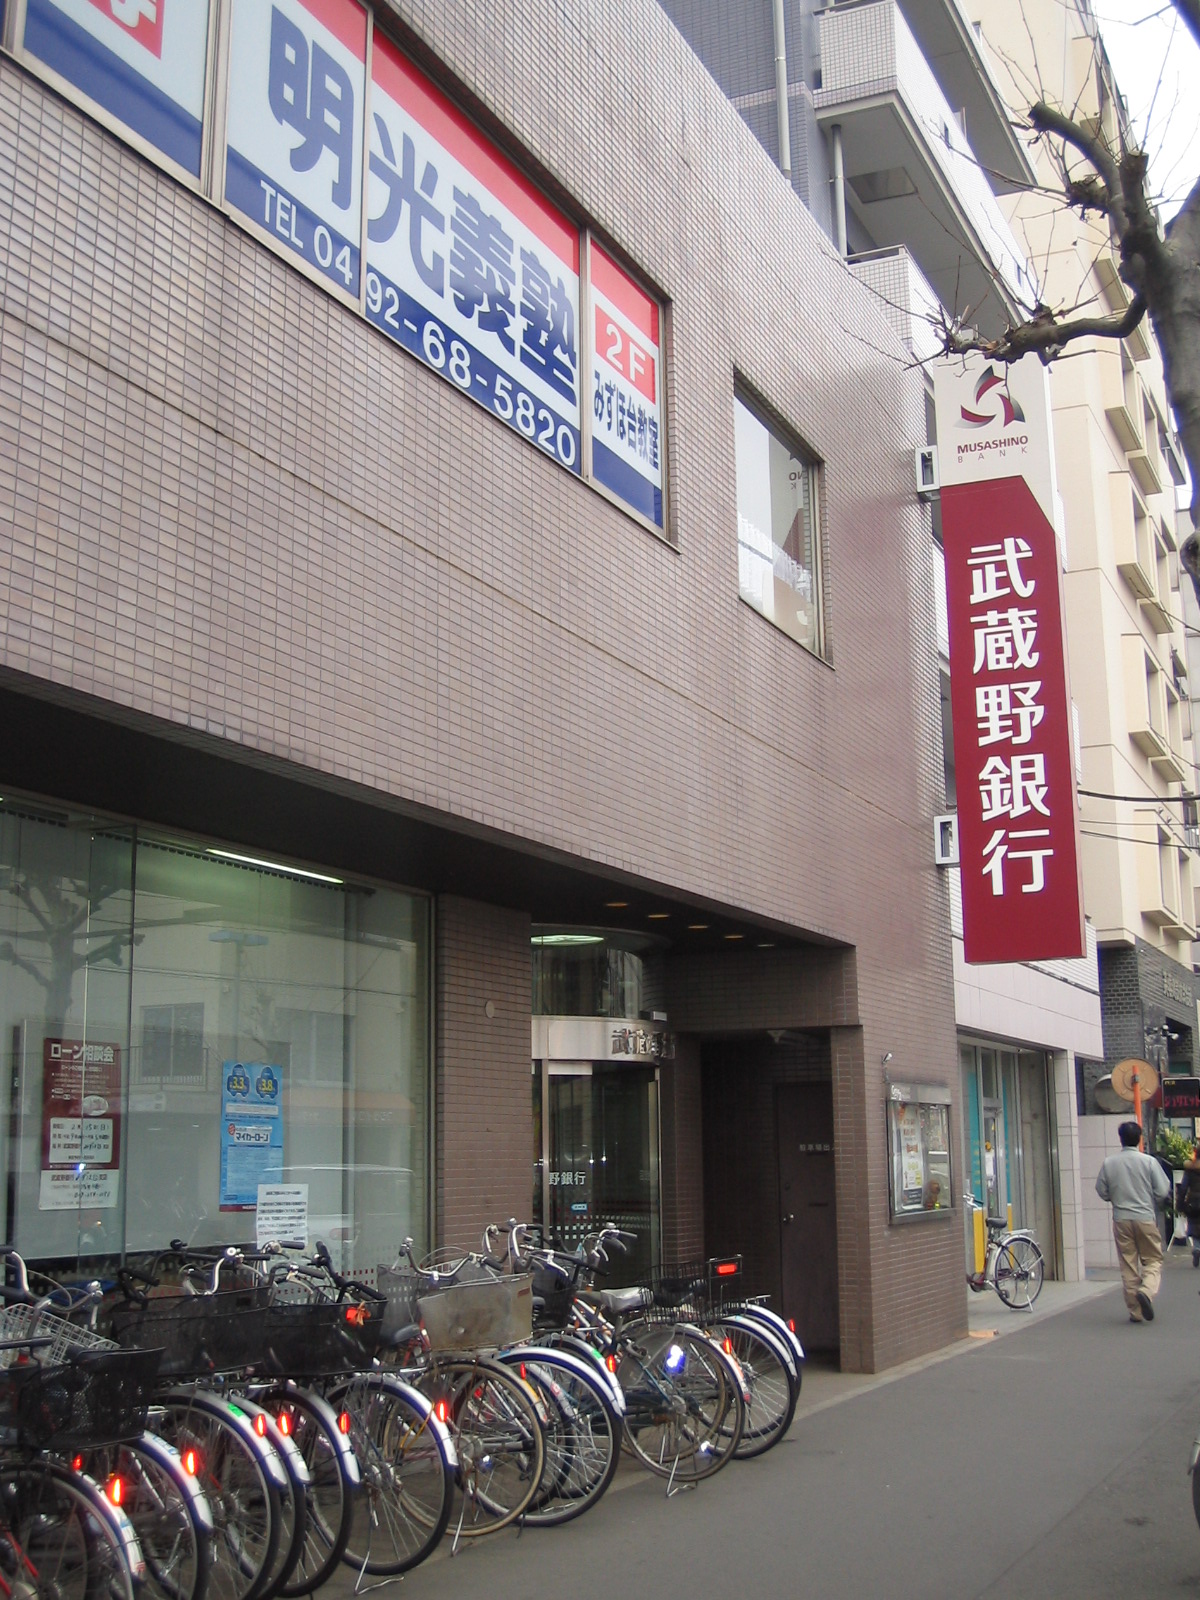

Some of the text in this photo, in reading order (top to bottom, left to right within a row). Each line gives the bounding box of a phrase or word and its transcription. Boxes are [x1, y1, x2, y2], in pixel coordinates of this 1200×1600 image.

[260, 180, 304, 249] TEL
[268, 4, 577, 408] 明光義塾
[606, 323, 646, 382] 2F
[594, 369, 659, 470] みずほ台教室
[957, 435, 1029, 454] MUSASHINO
[957, 446, 1028, 464] BANK
[967, 537, 1054, 896] 武蔵野銀行
[51, 1043, 114, 1062] ローン相談会
[235, 1132, 269, 1142] マイカーローン
